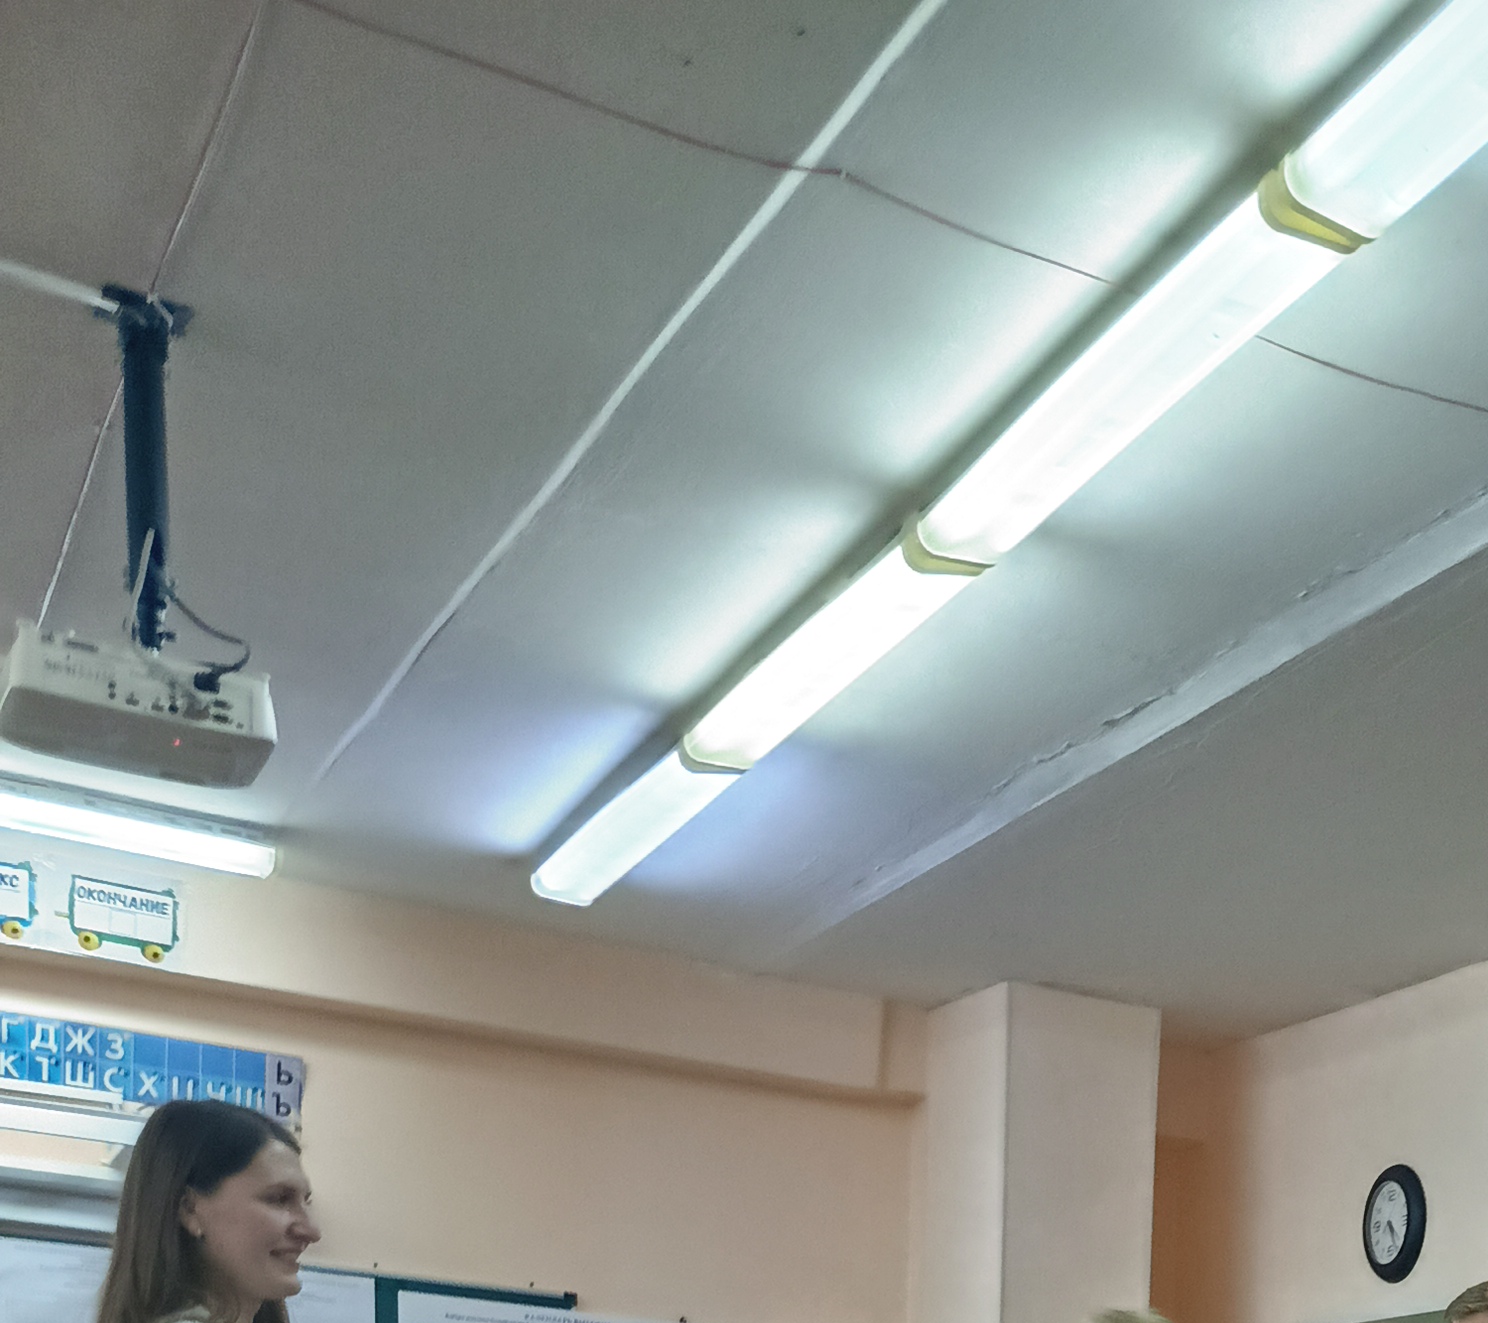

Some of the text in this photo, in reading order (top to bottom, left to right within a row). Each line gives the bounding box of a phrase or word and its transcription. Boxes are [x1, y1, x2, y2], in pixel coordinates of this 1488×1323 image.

[77, 885, 170, 915] ОКОНЧАНИЕ
[30, 1022, 58, 1054] Д
[65, 1026, 95, 1056] Ж
[105, 1033, 124, 1060] З
[35, 1055, 51, 1081] Т
[65, 1059, 94, 1089] Ш
[103, 1066, 124, 1093] С
[138, 1071, 159, 1099] Х
[277, 1060, 293, 1086] Ь
[272, 1091, 291, 1117] Ъ
